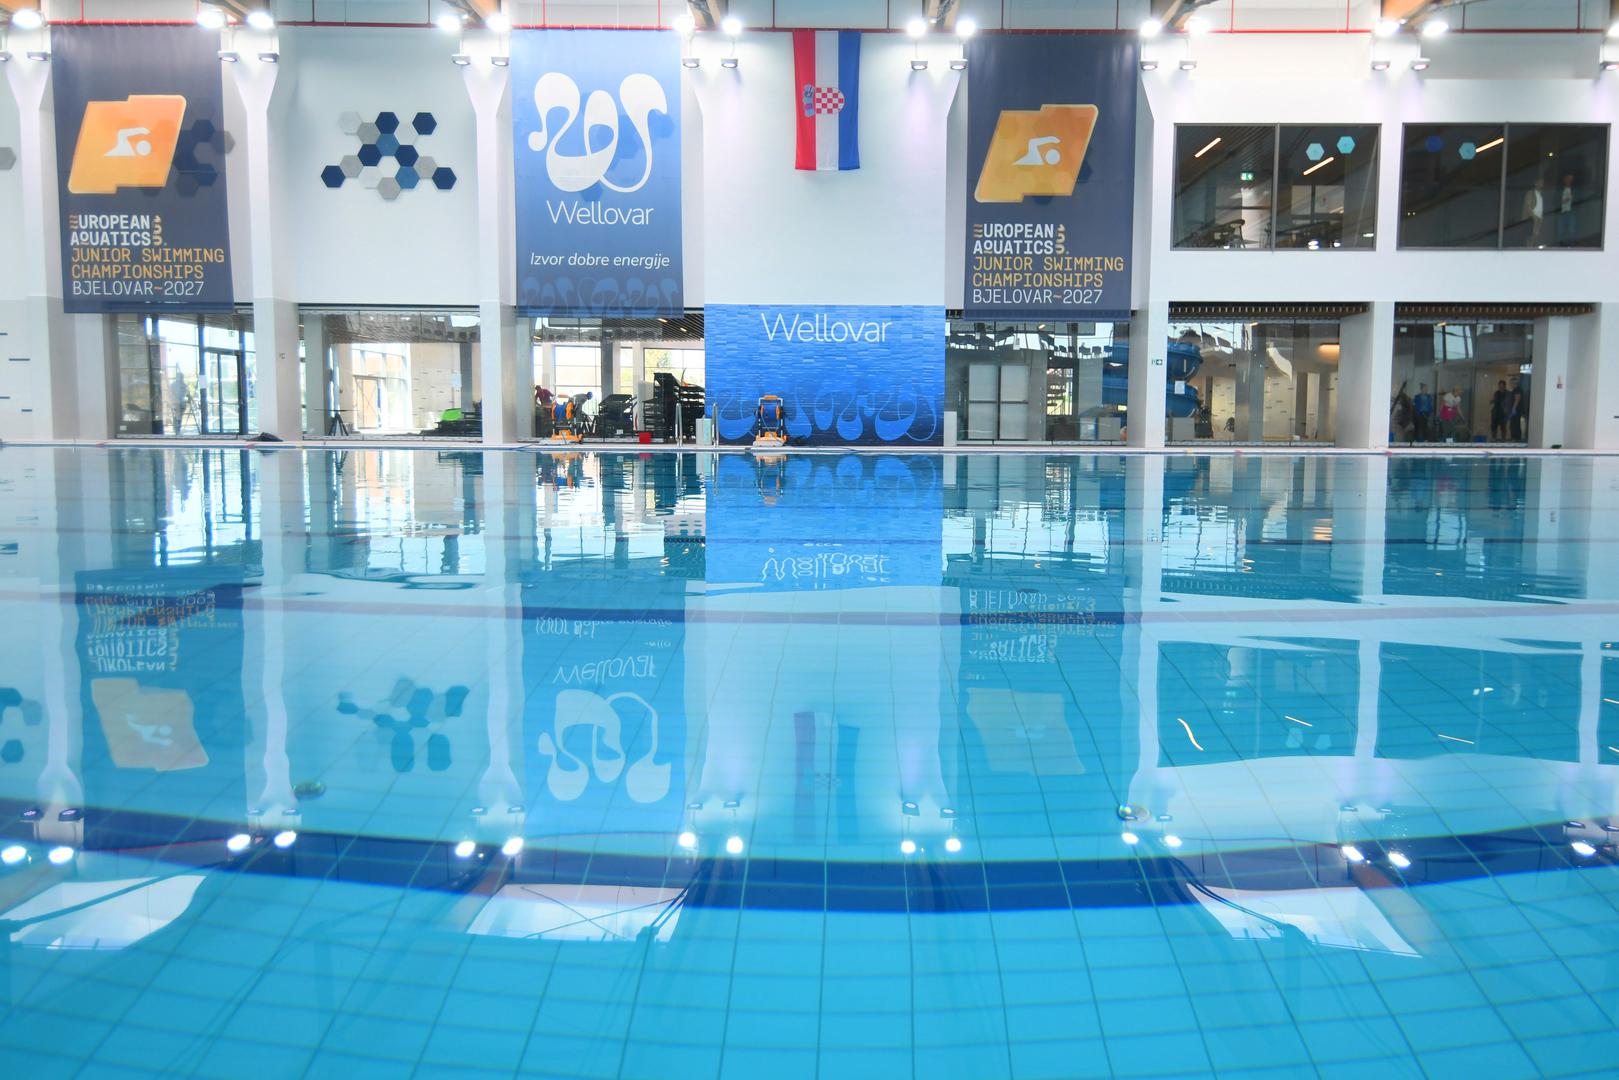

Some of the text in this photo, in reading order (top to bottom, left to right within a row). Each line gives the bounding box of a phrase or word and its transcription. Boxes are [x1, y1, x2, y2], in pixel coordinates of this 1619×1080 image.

[546, 200, 654, 225] Wellovar
[69, 214, 150, 229] EUROPEAN
[973, 223, 1054, 238] EUROPEAN
[70, 231, 151, 246] AQUATICS
[973, 240, 1054, 255] AQUATICS
[72, 248, 225, 263] JUNIOR SWIMMING
[530, 252, 670, 269] Izvor dobre energije
[71, 264, 204, 279] CHAMPIONSHIPS
[973, 256, 1124, 272] JUNIOR SWIMMING
[972, 272, 1104, 288] CHAMPIONSHIPS
[760, 312, 893, 343] Wellovar
